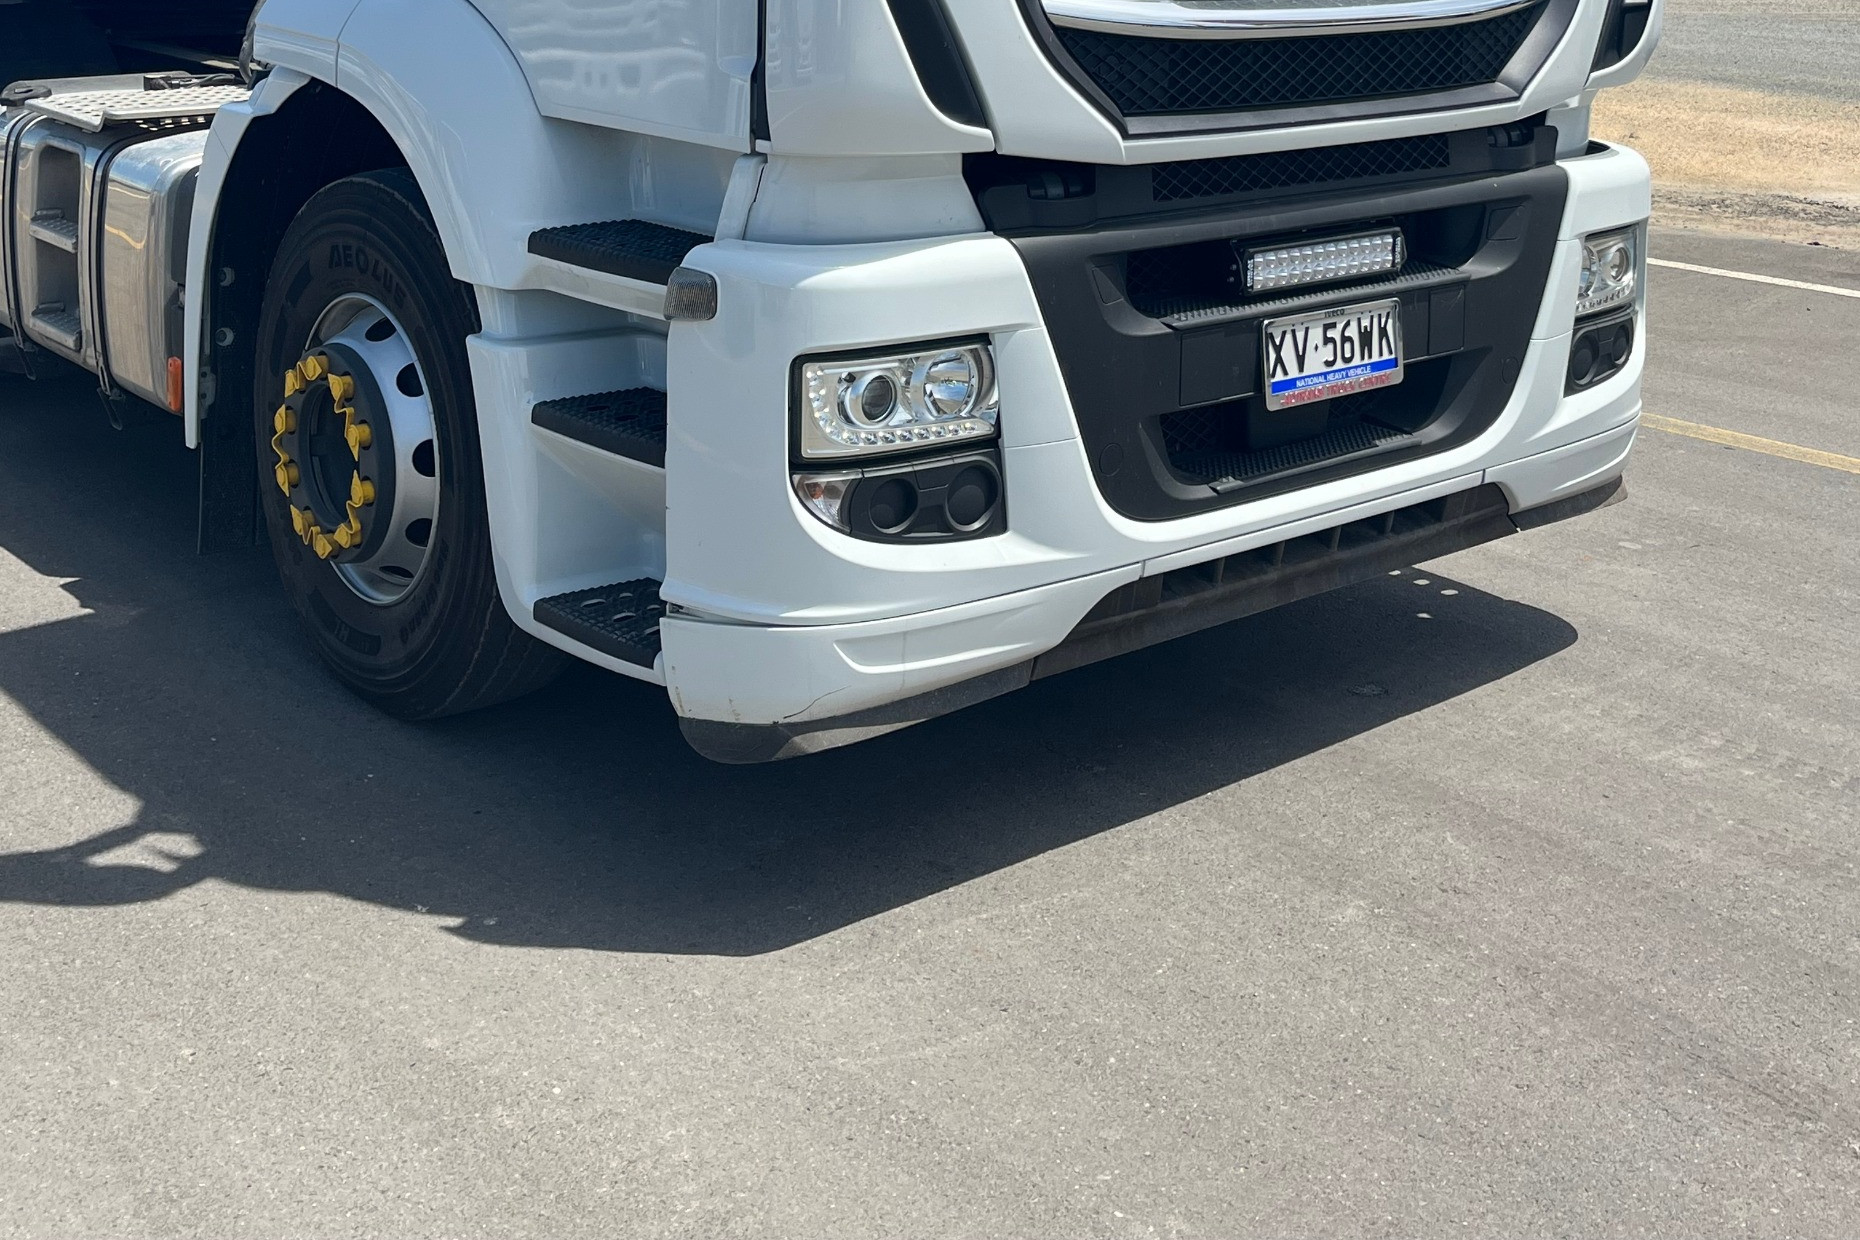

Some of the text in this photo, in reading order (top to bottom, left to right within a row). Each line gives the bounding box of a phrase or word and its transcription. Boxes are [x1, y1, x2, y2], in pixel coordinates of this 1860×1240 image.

[328, 244, 407, 309] AEOLUS
[1296, 365, 1372, 388] NATIONAL HEAVY VEHICLE
